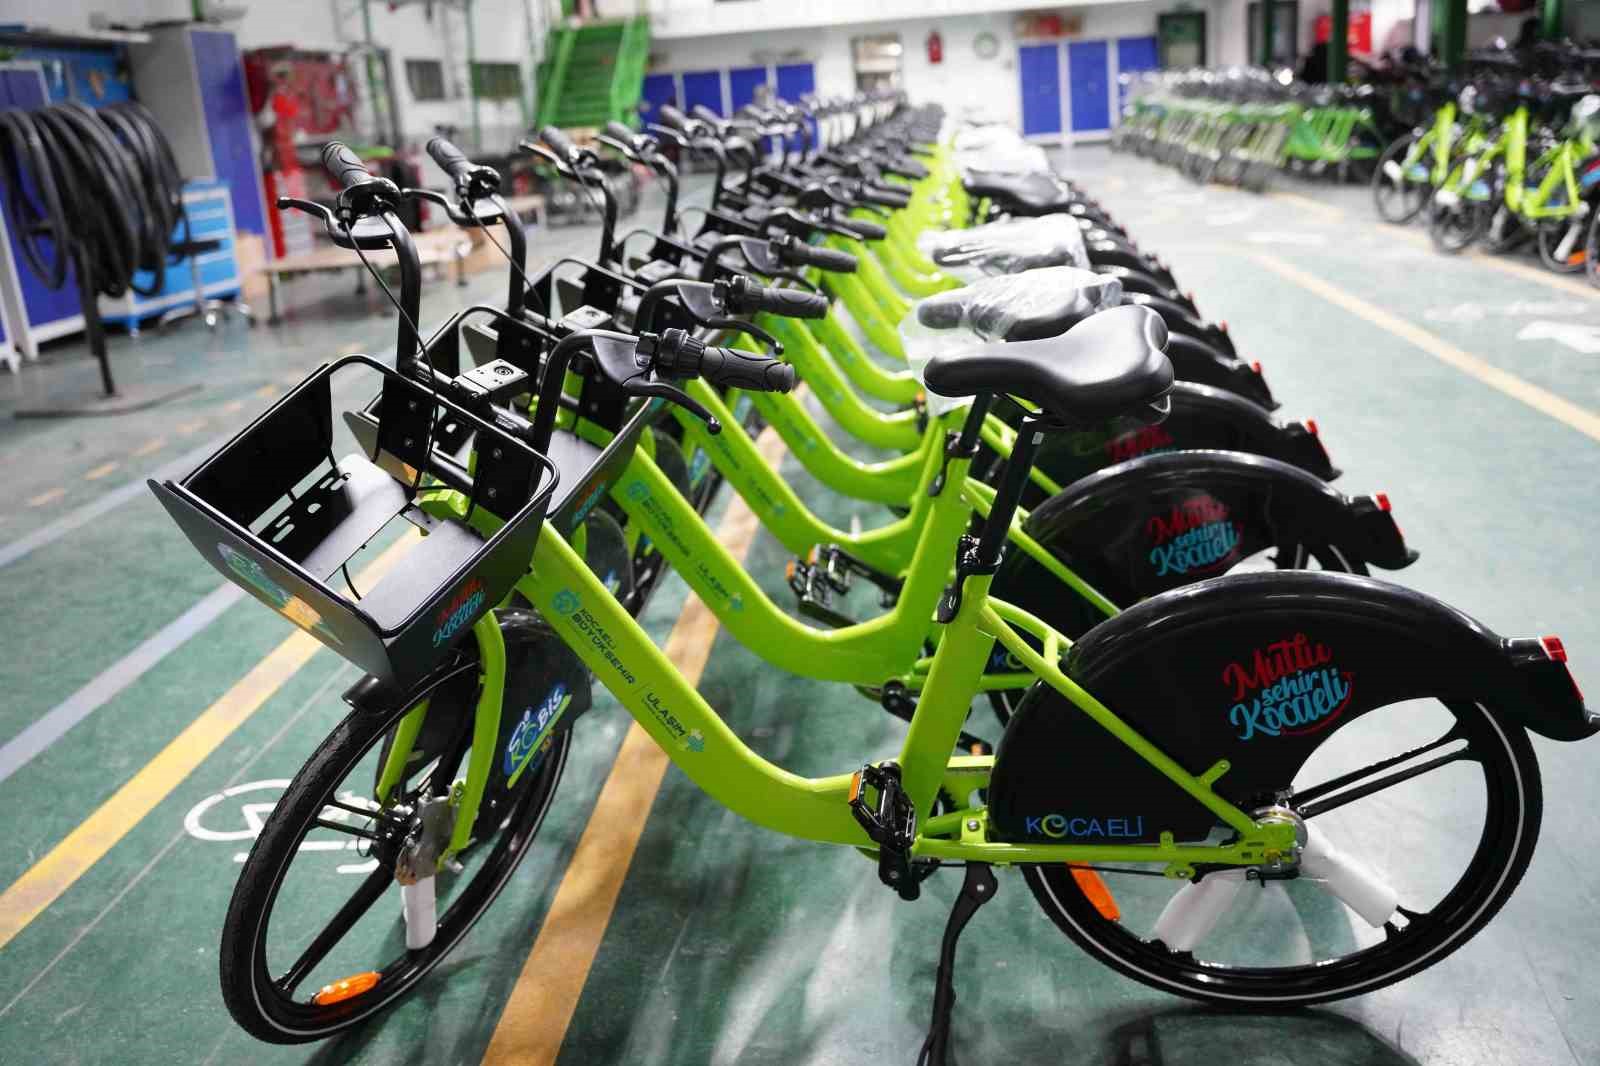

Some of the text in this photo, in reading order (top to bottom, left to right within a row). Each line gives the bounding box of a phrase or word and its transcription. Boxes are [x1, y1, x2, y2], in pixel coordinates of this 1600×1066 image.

[1150, 520, 1239, 577] Kocaeli
[1222, 632, 1333, 701] Mutlu
[1229, 667, 1349, 740] Kocaeli
